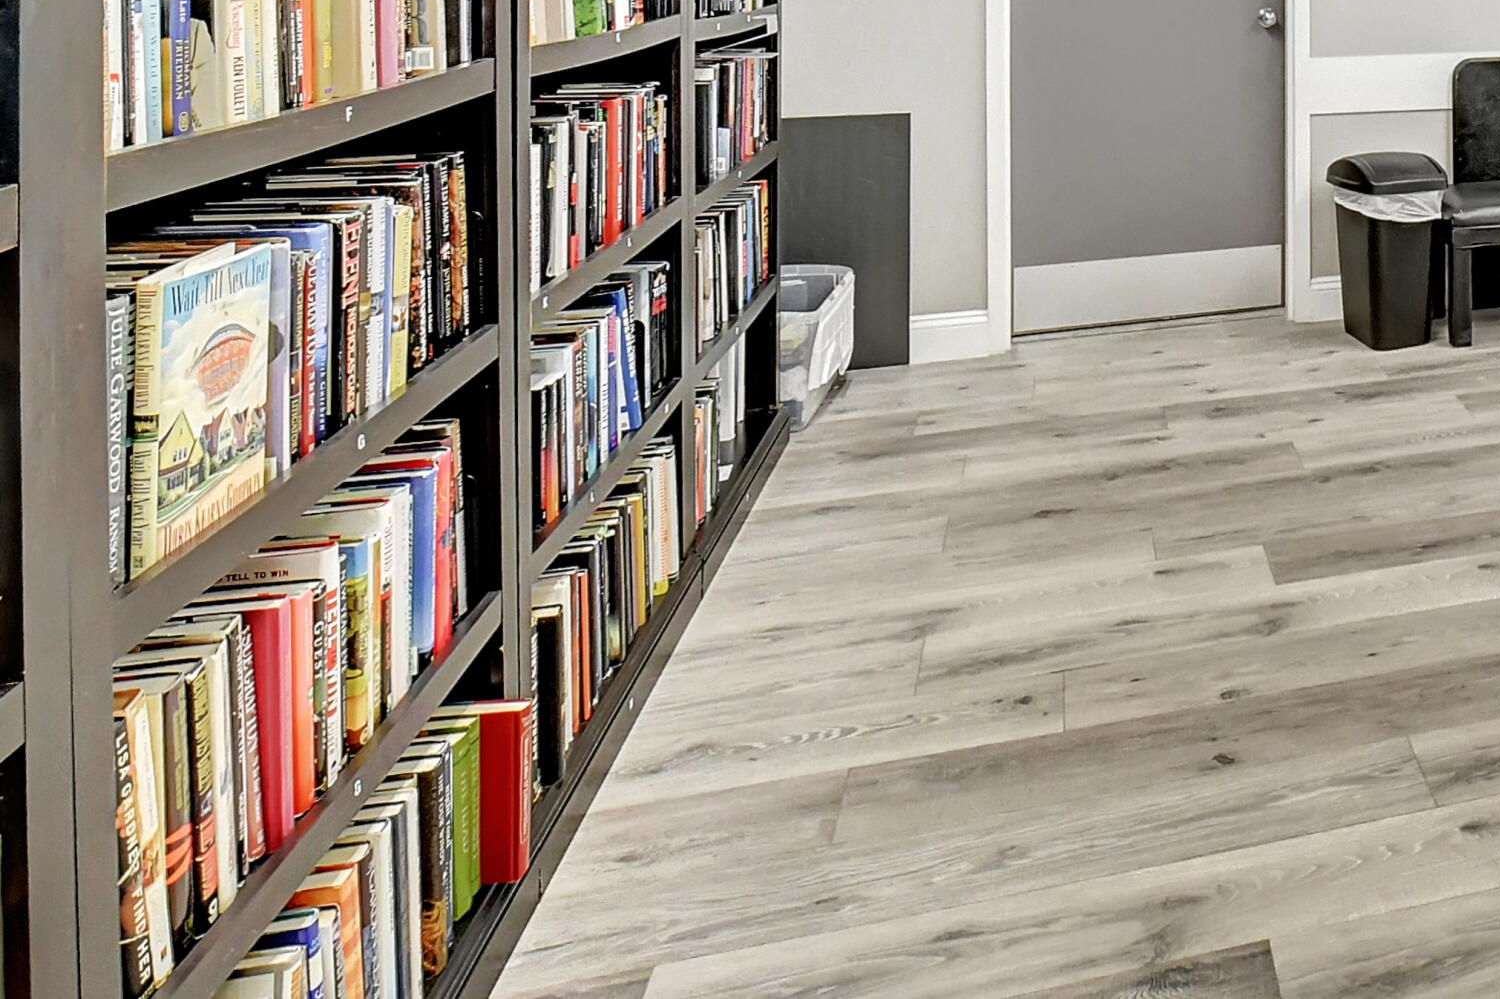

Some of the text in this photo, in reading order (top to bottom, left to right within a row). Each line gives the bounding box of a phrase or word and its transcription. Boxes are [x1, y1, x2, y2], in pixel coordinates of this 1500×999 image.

[178, 0, 188, 23] Late
[175, 39, 184, 100] FRIEDMAN
[232, 56, 246, 117] KEN FOLLETT
[345, 106, 353, 122] F
[441, 186, 449, 237] TESTAMENT
[172, 257, 269, 316] Wait Till Next Year
[295, 295, 303, 348] GRISHAM
[305, 292, 316, 367] GRAFTON
[344, 221, 361, 413] ELENI NICHOLAS GAGE
[107, 305, 127, 574] JULIE GARWOOD RANSOM
[290, 400, 300, 454] LITIGATORS
[357, 433, 365, 450] G
[131, 449, 152, 475] Wait
[132, 478, 152, 494] Till
[132, 523, 151, 549] Year
[225, 569, 289, 582] TELL TO WIN
[327, 598, 338, 648] TELL
[313, 620, 325, 680] GUEST
[243, 667, 258, 754] GRAFTON
[327, 666, 338, 711] WIN
[353, 779, 362, 796] G
[115, 731, 152, 985] LISA GARDNER FIND HER
